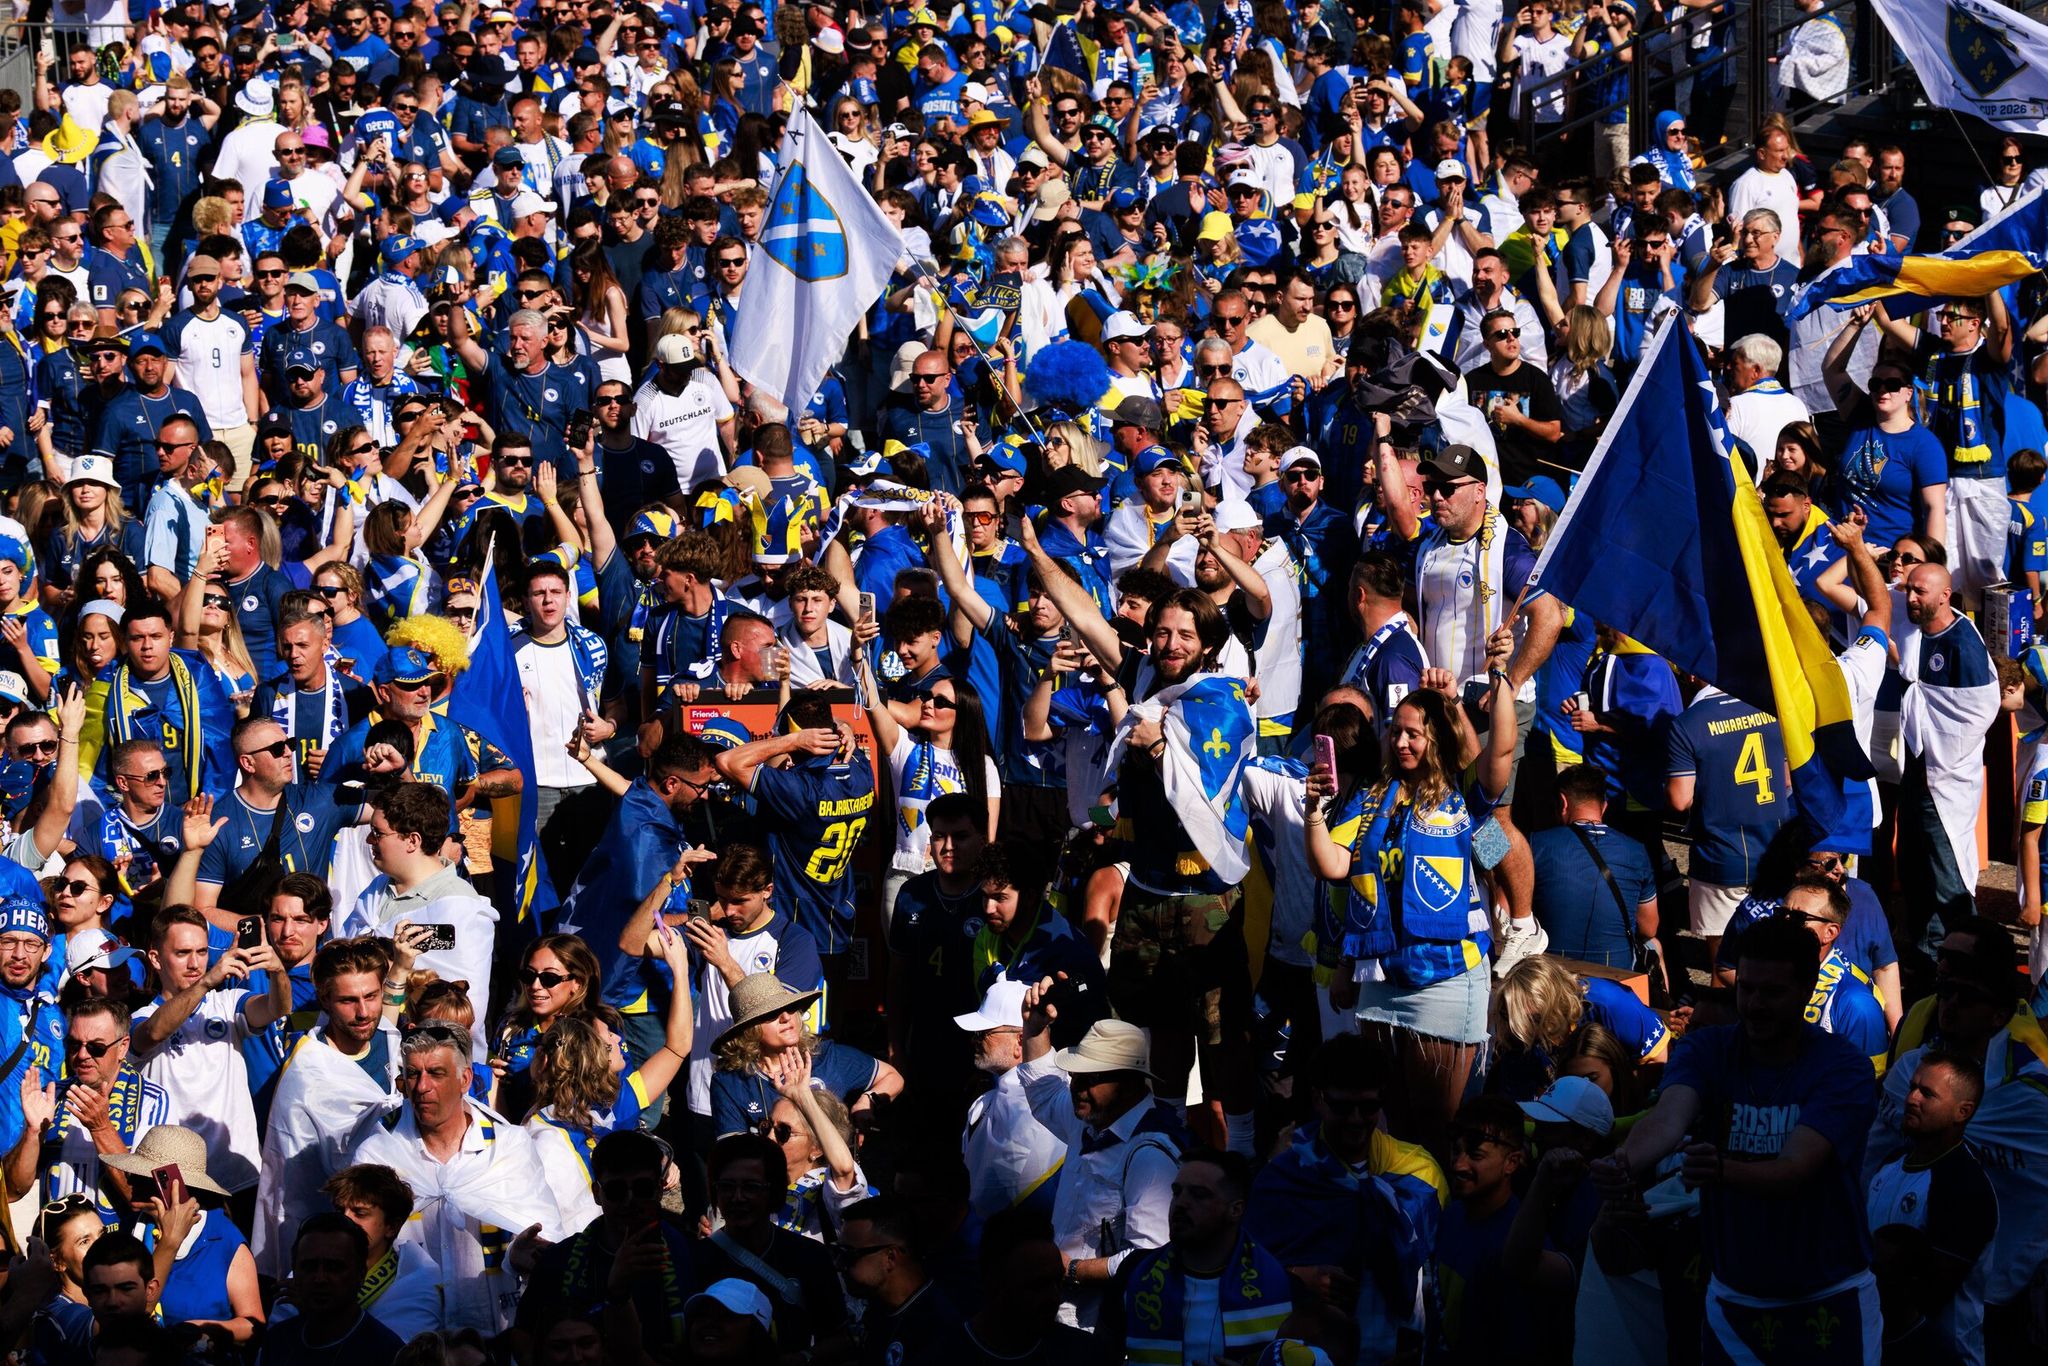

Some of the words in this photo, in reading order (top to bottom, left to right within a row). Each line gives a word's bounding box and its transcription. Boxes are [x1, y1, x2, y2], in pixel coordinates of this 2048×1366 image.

[1999, 104, 2027, 115] 2026
[171, 151, 182, 168] 4
[212, 348, 222, 368] 9
[659, 405, 712, 429] DEUTSCHLAND
[1342, 424, 1358, 445] 19
[2020, 616, 2028, 645] ULTRA
[692, 710, 719, 719] Friends
[721, 711, 731, 719] of
[163, 722, 178, 749] 9
[1090, 742, 1105, 769] 4
[1734, 731, 1776, 805] 4
[1446, 825, 1463, 836] AND
[804, 817, 867, 884] 20
[928, 945, 945, 977] 4
[1803, 963, 1846, 1024] OSNA
[32, 1041, 50, 1070] 20
